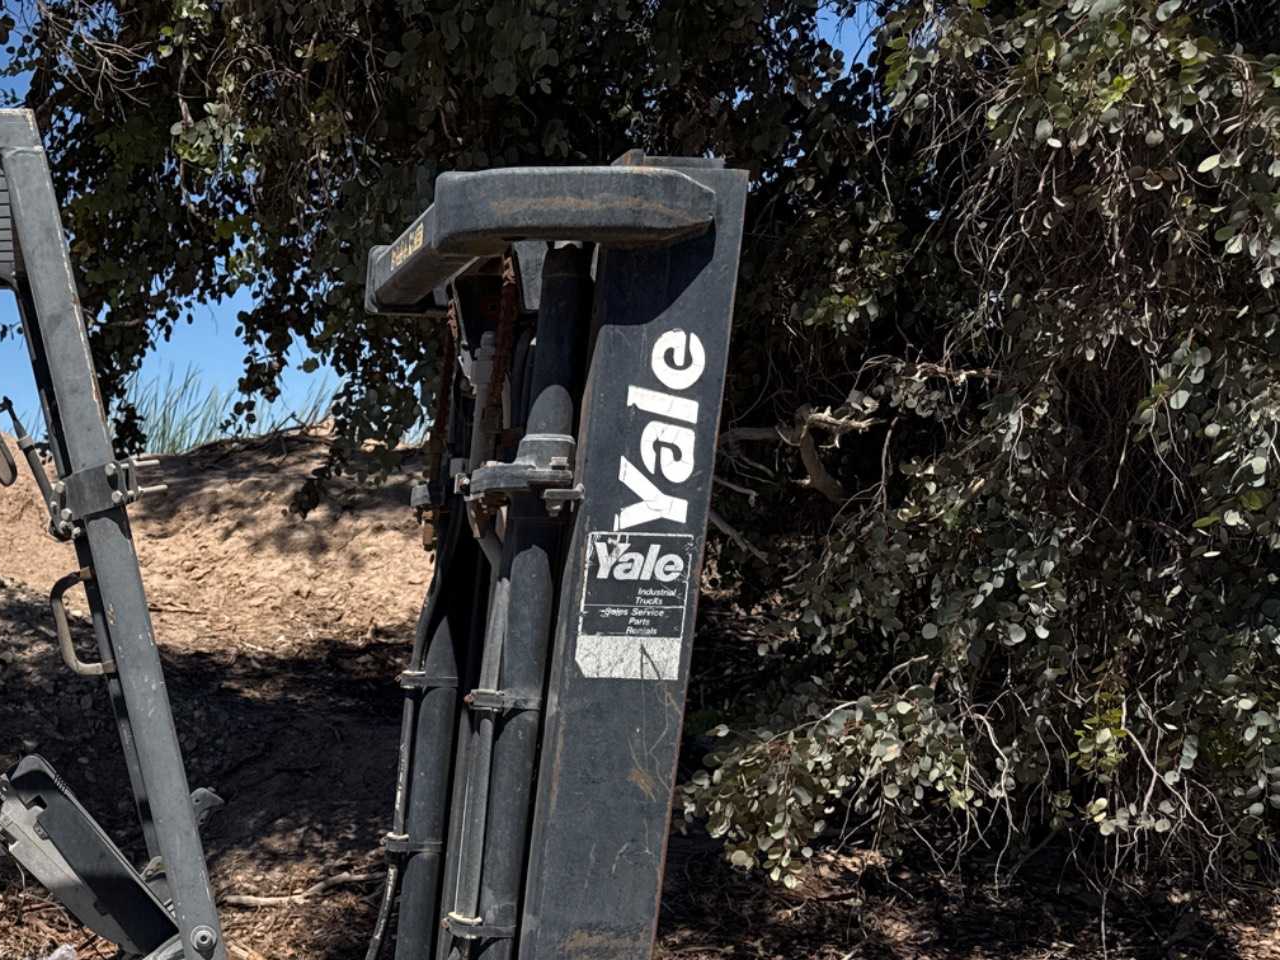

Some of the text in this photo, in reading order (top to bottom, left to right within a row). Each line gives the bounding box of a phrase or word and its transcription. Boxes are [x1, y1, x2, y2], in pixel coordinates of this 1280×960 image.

[613, 328, 706, 532] Yale
[594, 541, 684, 582] Yale
[638, 586, 677, 597] Industrial
[635, 596, 663, 606] Trucks
[631, 607, 665, 617] Service
[628, 616, 650, 627] Parts
[625, 626, 658, 635] Rentals
